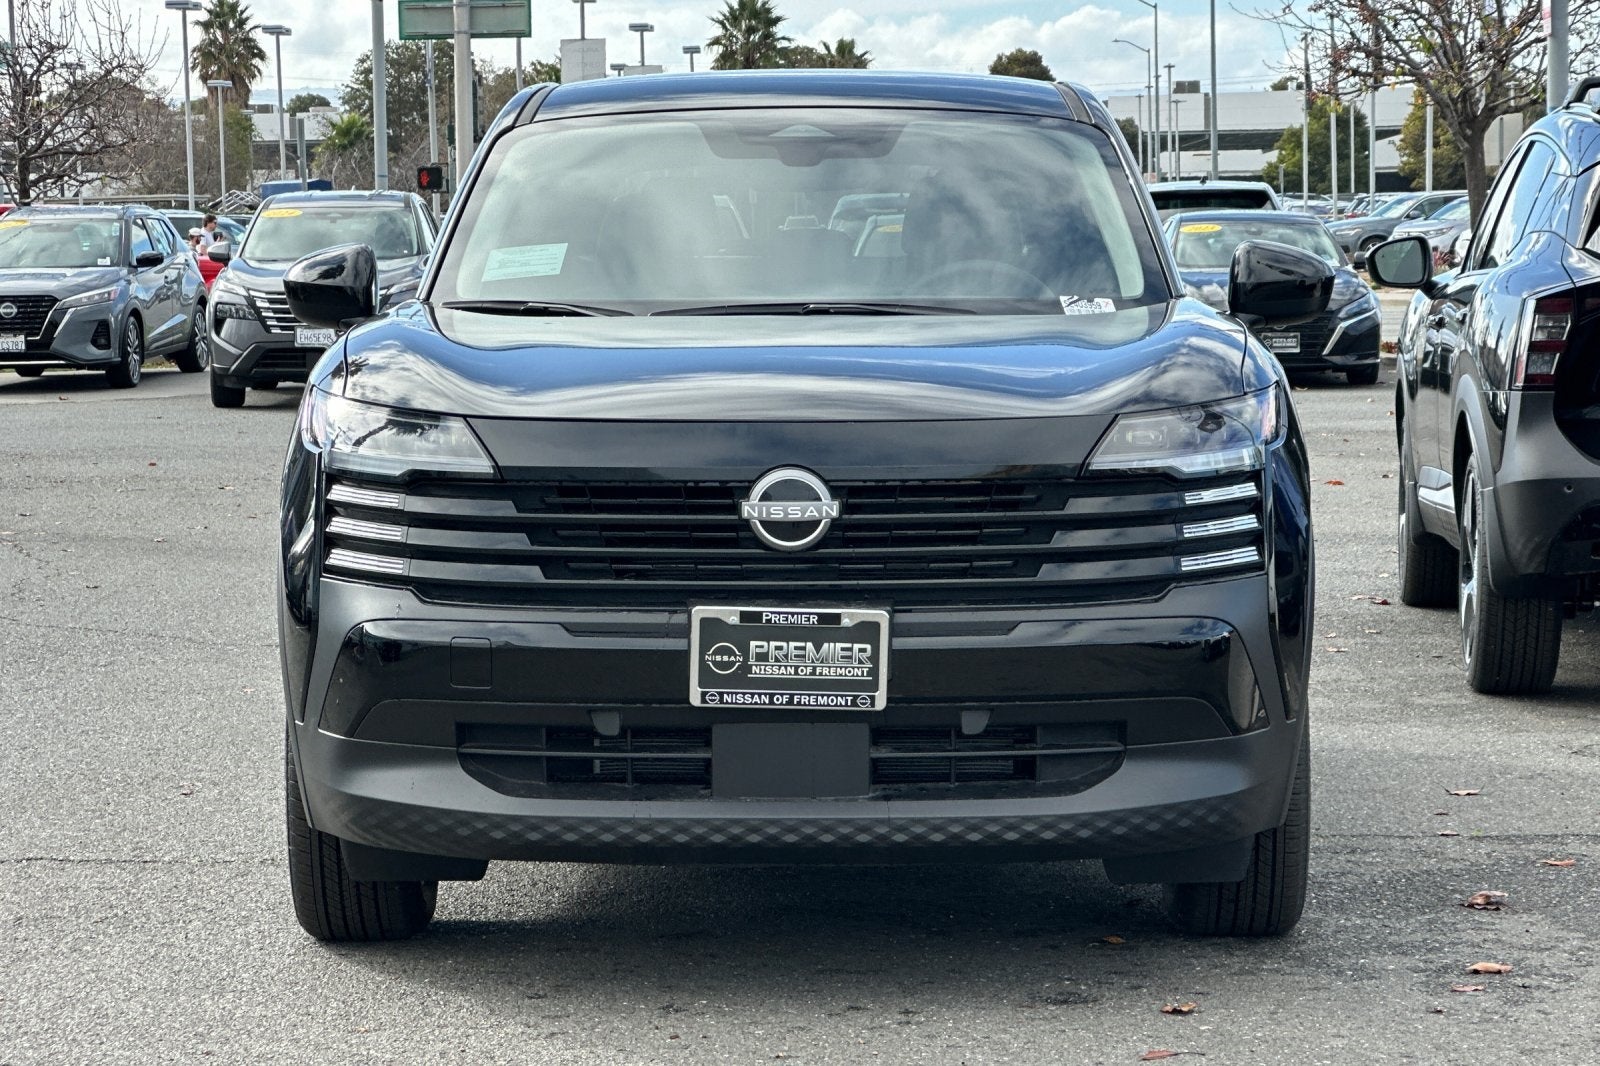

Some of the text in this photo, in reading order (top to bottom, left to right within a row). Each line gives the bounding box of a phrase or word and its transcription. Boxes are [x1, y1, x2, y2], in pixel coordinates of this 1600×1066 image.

[744, 505, 837, 518] NISSAN
[762, 613, 818, 624] PREMIER
[705, 654, 743, 662] NISSAN
[749, 640, 872, 665] PREMIER
[752, 666, 869, 676] NISSAN OF FREMONT
[723, 693, 854, 706] NISSAN OF FREMONT
